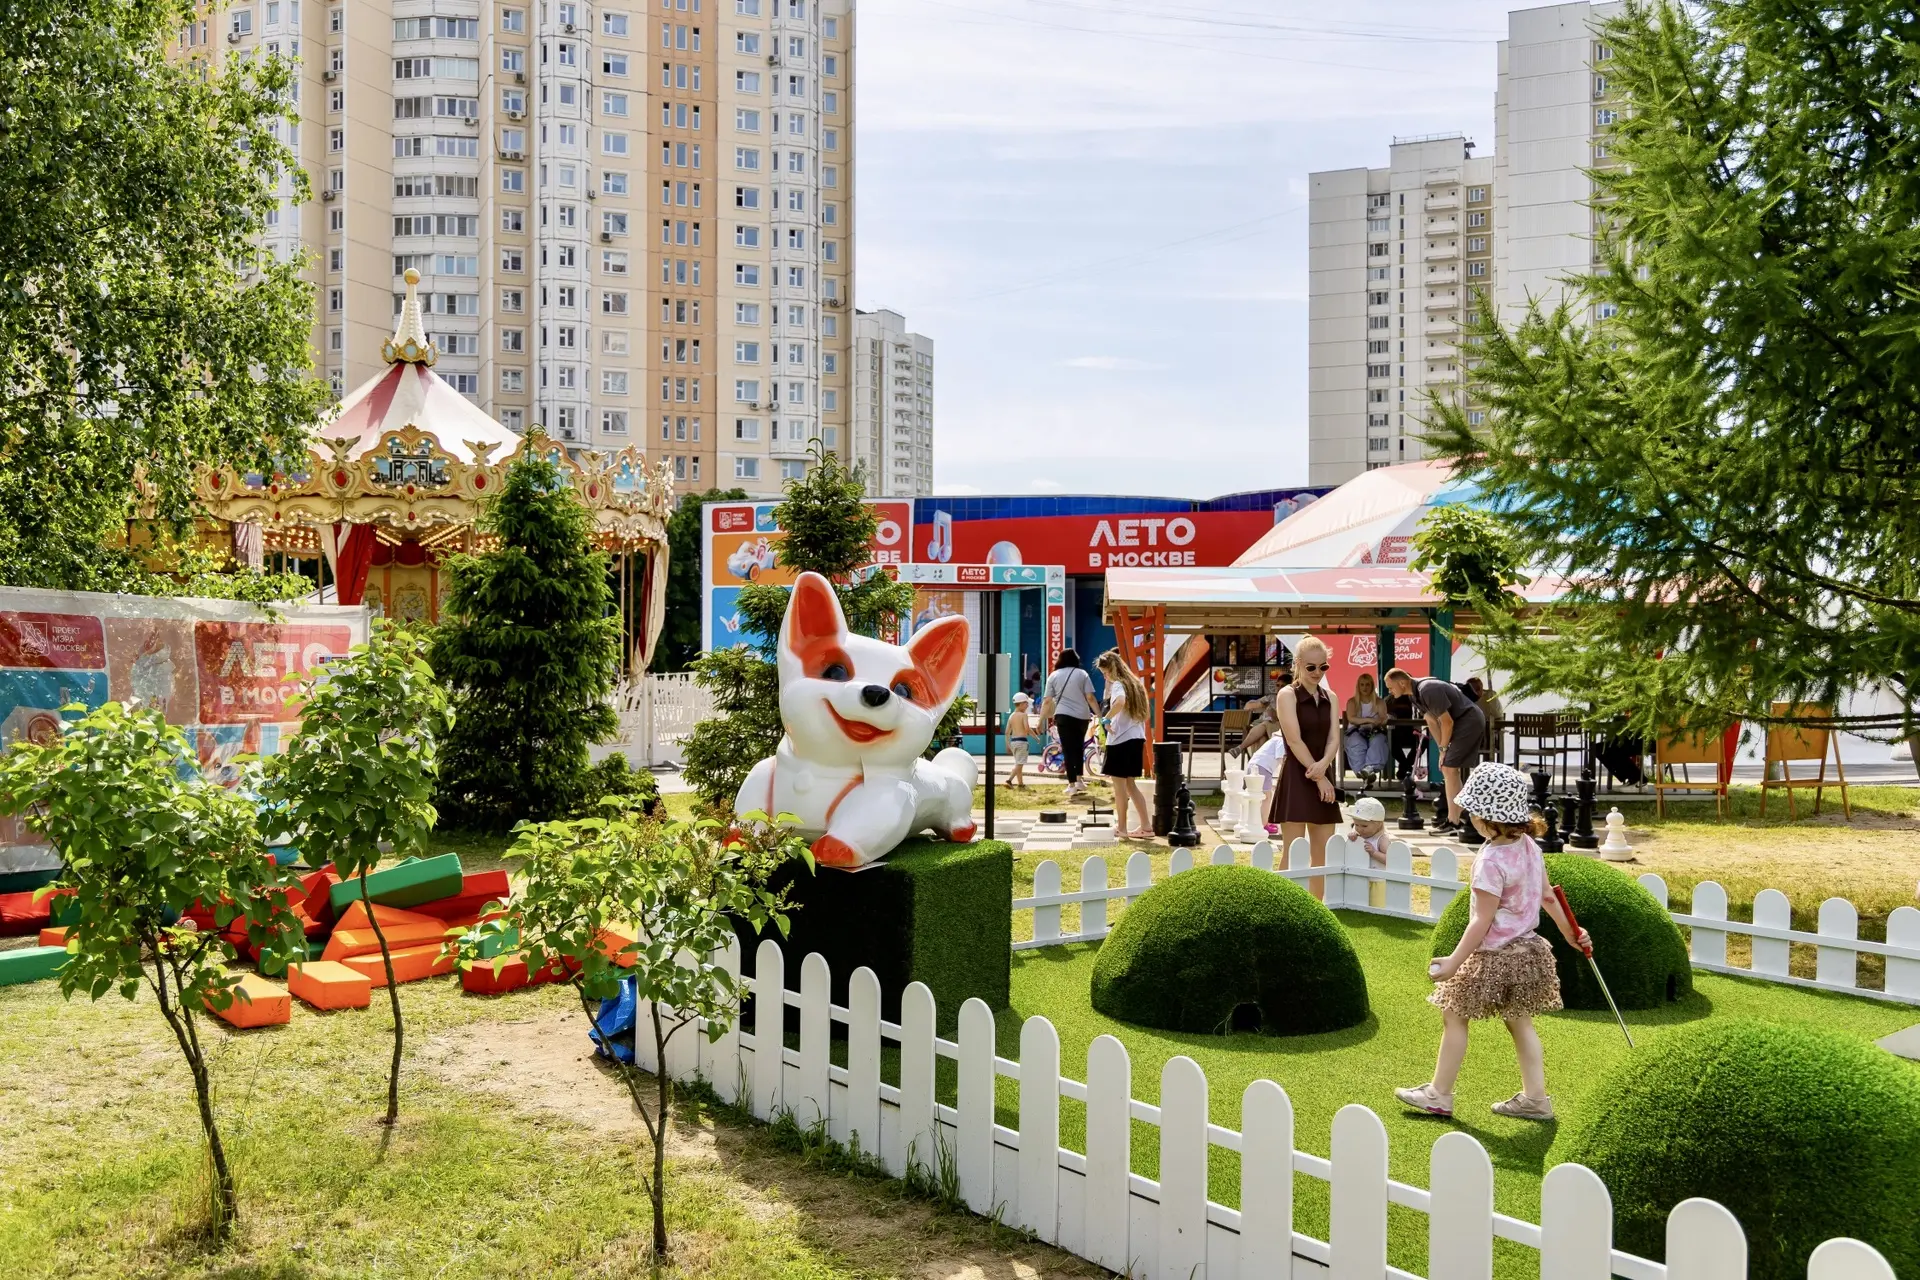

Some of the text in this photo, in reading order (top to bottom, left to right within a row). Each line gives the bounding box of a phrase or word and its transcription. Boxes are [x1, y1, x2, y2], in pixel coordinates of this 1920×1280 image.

[1089, 517, 1196, 547] ЛЕТО
[1089, 551, 1196, 567] В МОСКВЕ
[961, 568, 986, 576] ЛЕТО
[52, 626, 80, 635] ПРОЕКТ
[52, 635, 75, 643] МЭРА
[1394, 637, 1421, 645] РОЕКТ
[52, 644, 87, 652] МОСКВЫ
[1394, 645, 1410, 653] ЭРА
[220, 686, 235, 705] В
